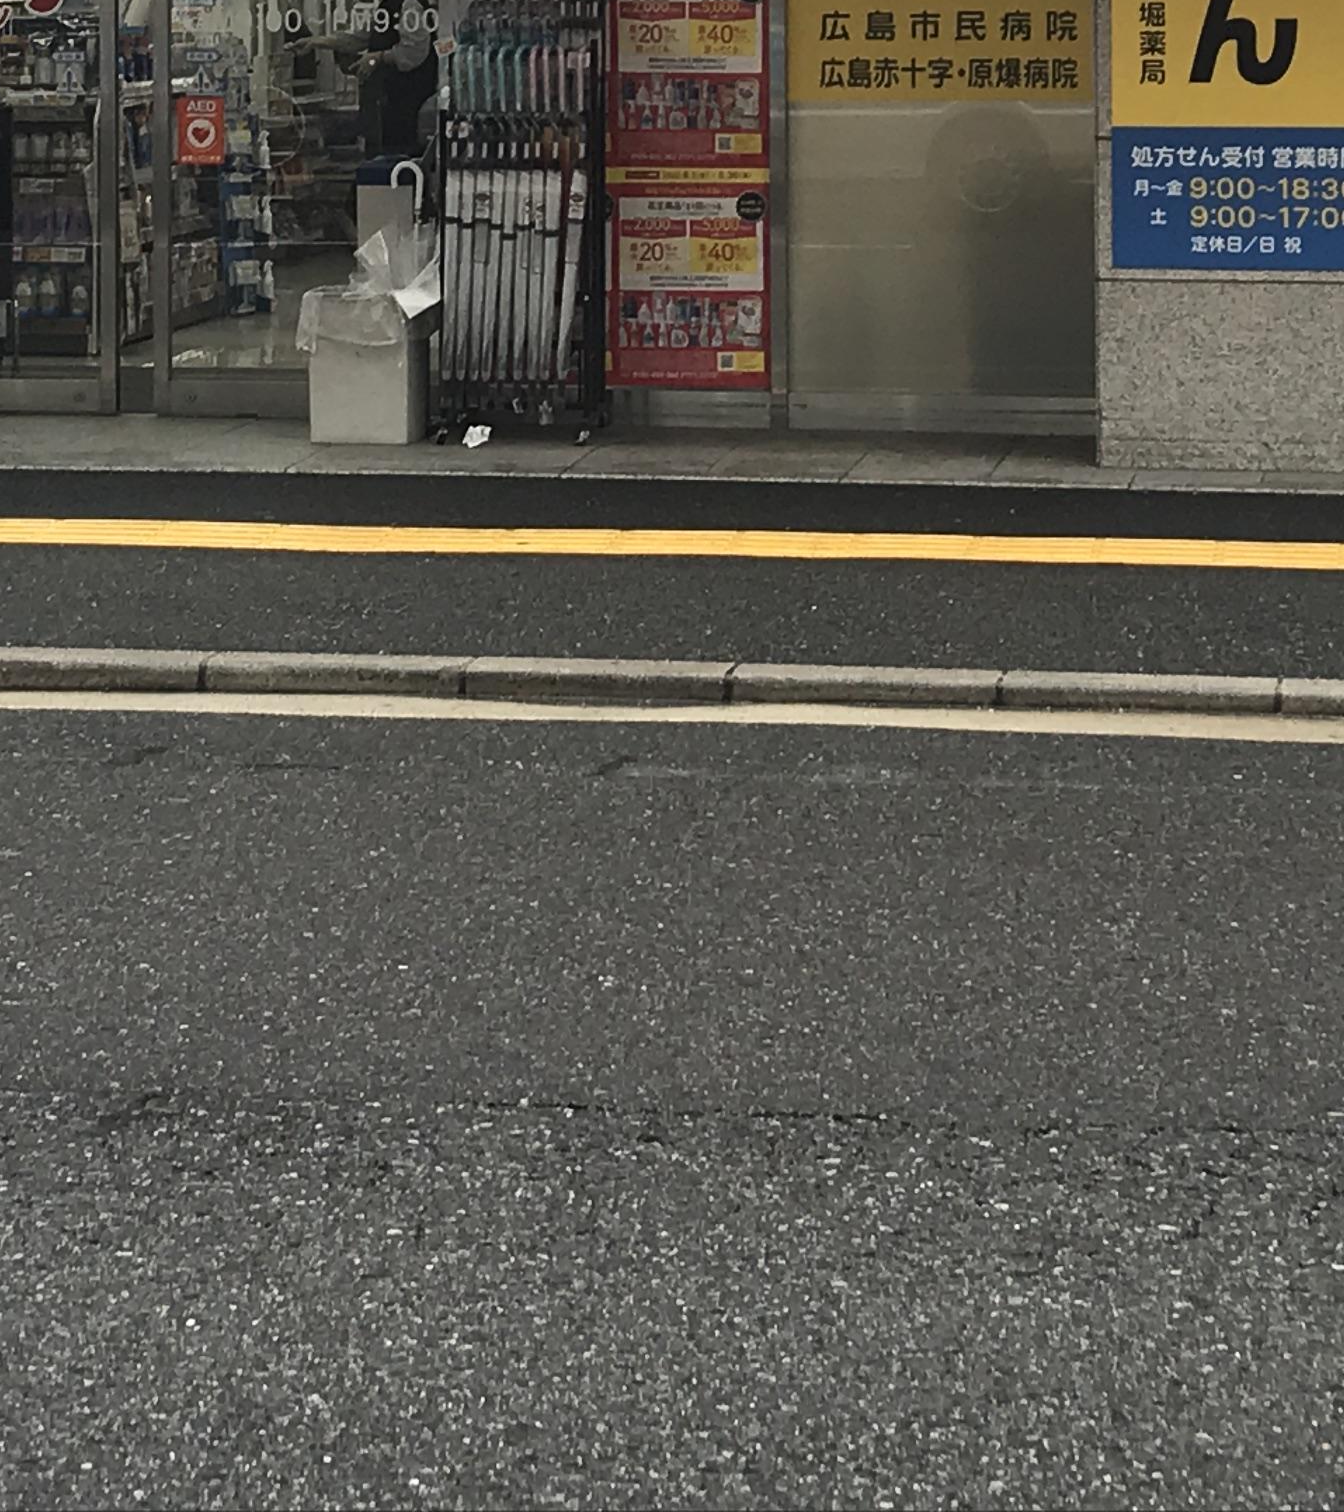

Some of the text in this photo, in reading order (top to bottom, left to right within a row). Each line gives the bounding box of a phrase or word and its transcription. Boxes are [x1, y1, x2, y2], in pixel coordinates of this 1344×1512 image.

[819, 9, 1079, 43] 広島市民病院
[819, 56, 1079, 90] 広島赤十字・原爆病院
[186, 100, 216, 113] AED
[1131, 146, 1265, 169] 処方せん受付
[1134, 178, 1184, 198] 月～金
[1149, 207, 1168, 226] 土
[1284, 235, 1303, 254] 祝
